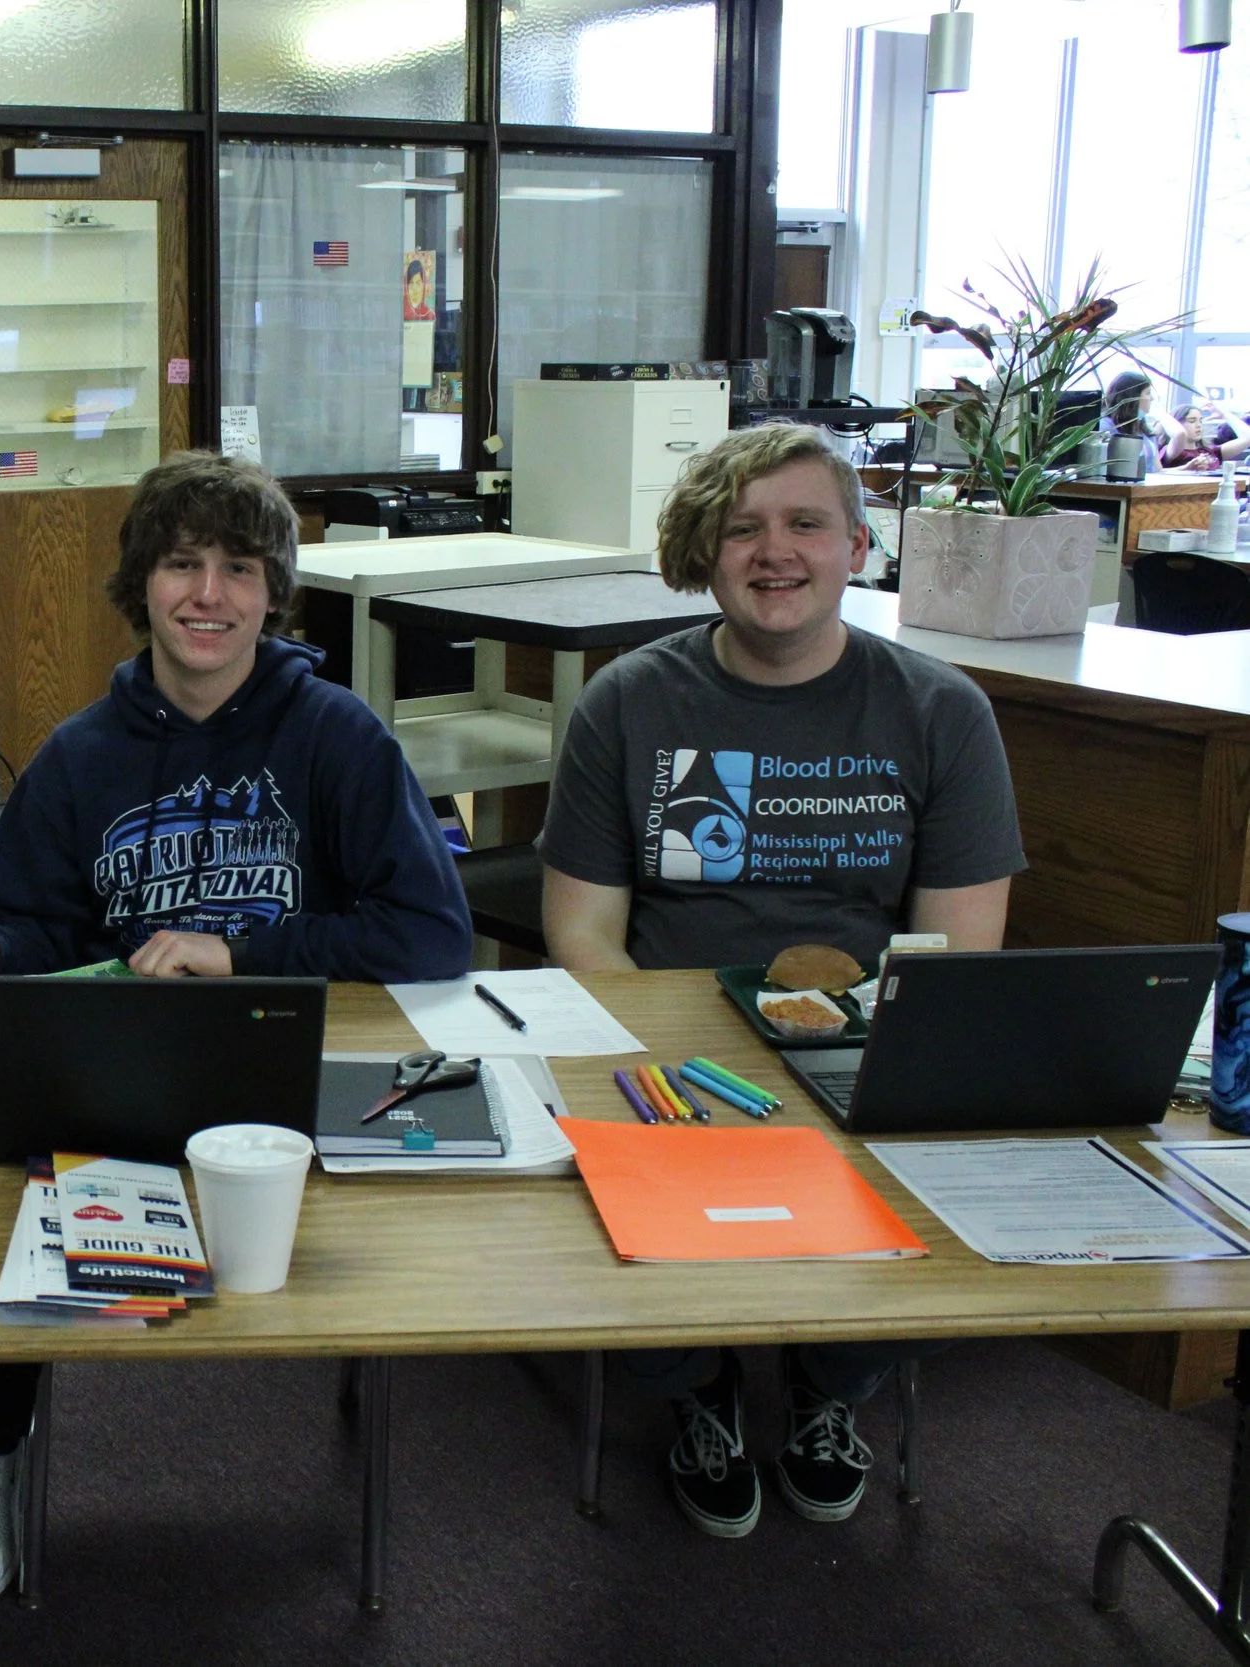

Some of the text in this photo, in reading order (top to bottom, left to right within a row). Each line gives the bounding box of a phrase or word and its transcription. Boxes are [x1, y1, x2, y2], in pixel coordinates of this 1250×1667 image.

[759, 753, 899, 778] Blood Drive
[645, 749, 673, 877] WILL YOU GIVE?
[755, 795, 906, 816] COORDINATOR
[751, 833, 846, 852] Mississippi
[837, 851, 890, 868] Blood
[110, 868, 291, 915] INVITATONAL
[77, 1238, 195, 1259] THE GUIDE
